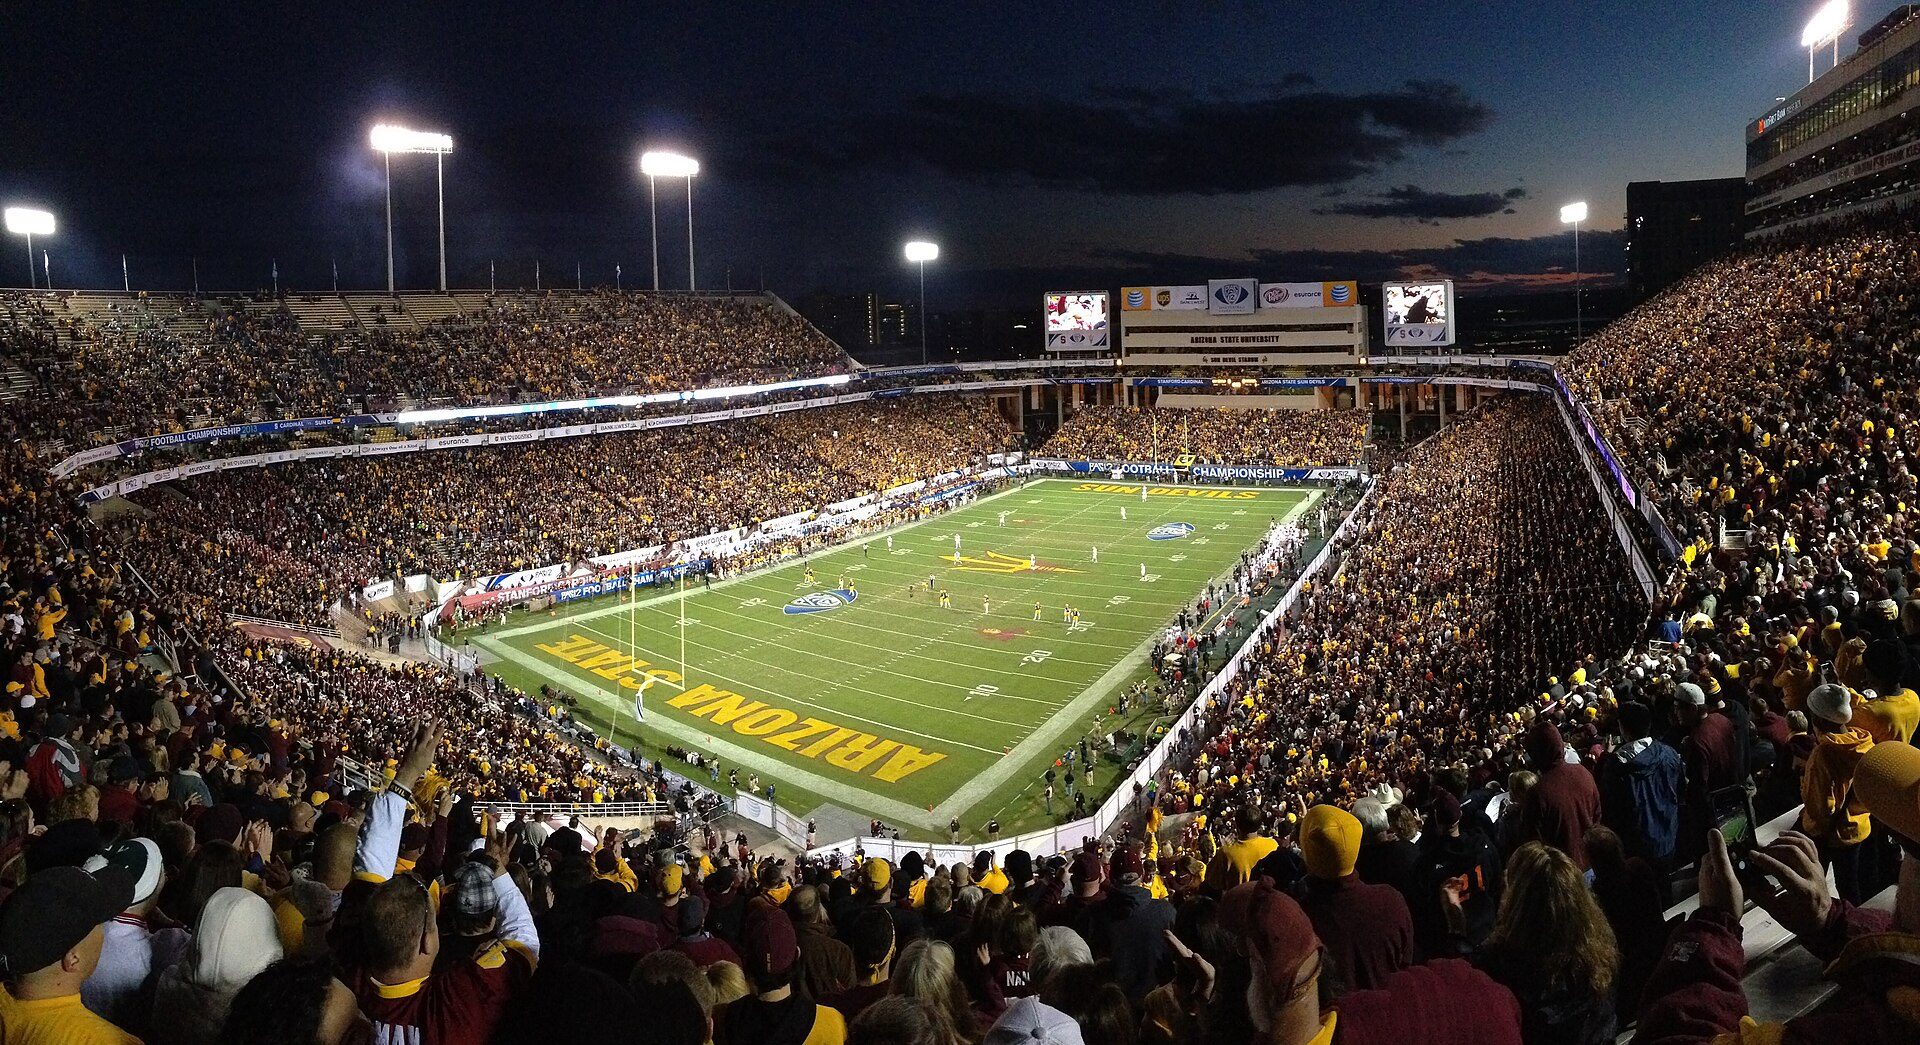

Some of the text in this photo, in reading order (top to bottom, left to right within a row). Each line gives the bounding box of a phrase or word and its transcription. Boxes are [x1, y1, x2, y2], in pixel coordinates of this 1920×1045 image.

[150, 434, 186, 447] FOOTBALL
[187, 426, 241, 441] CHAMPIONSHIP
[241, 425, 258, 434] 2013
[189, 464, 210, 472] esurance
[1192, 467, 1284, 480] CHAMPIONSHIP
[1071, 484, 1260, 499] SUN DEVILS
[696, 534, 727, 547] esurance
[534, 634, 683, 689] STATE
[1022, 650, 1052, 663] 20
[969, 684, 999, 696] 10
[666, 683, 948, 783] ARIZONA
